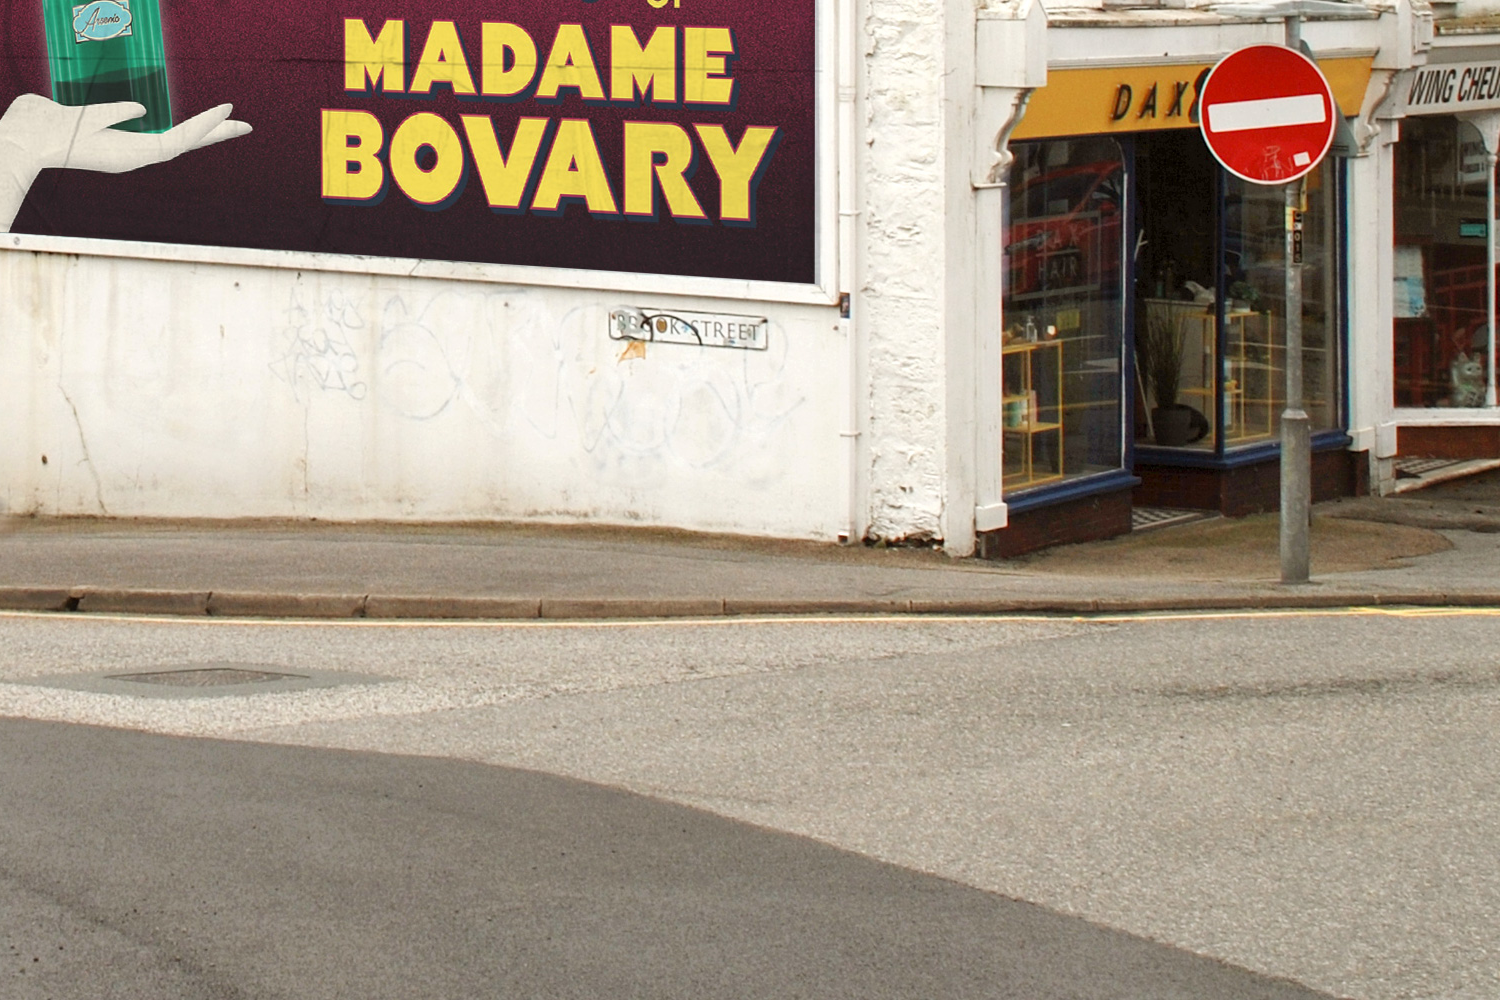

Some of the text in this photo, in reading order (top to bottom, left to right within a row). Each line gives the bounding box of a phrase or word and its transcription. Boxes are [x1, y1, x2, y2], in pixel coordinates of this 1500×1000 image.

[344, 18, 740, 110] MADAME
[1109, 81, 1190, 121] DAX
[1407, 66, 1500, 106] WING CHEU
[321, 109, 783, 225] BOVARY
[690, 319, 760, 341] STREET
